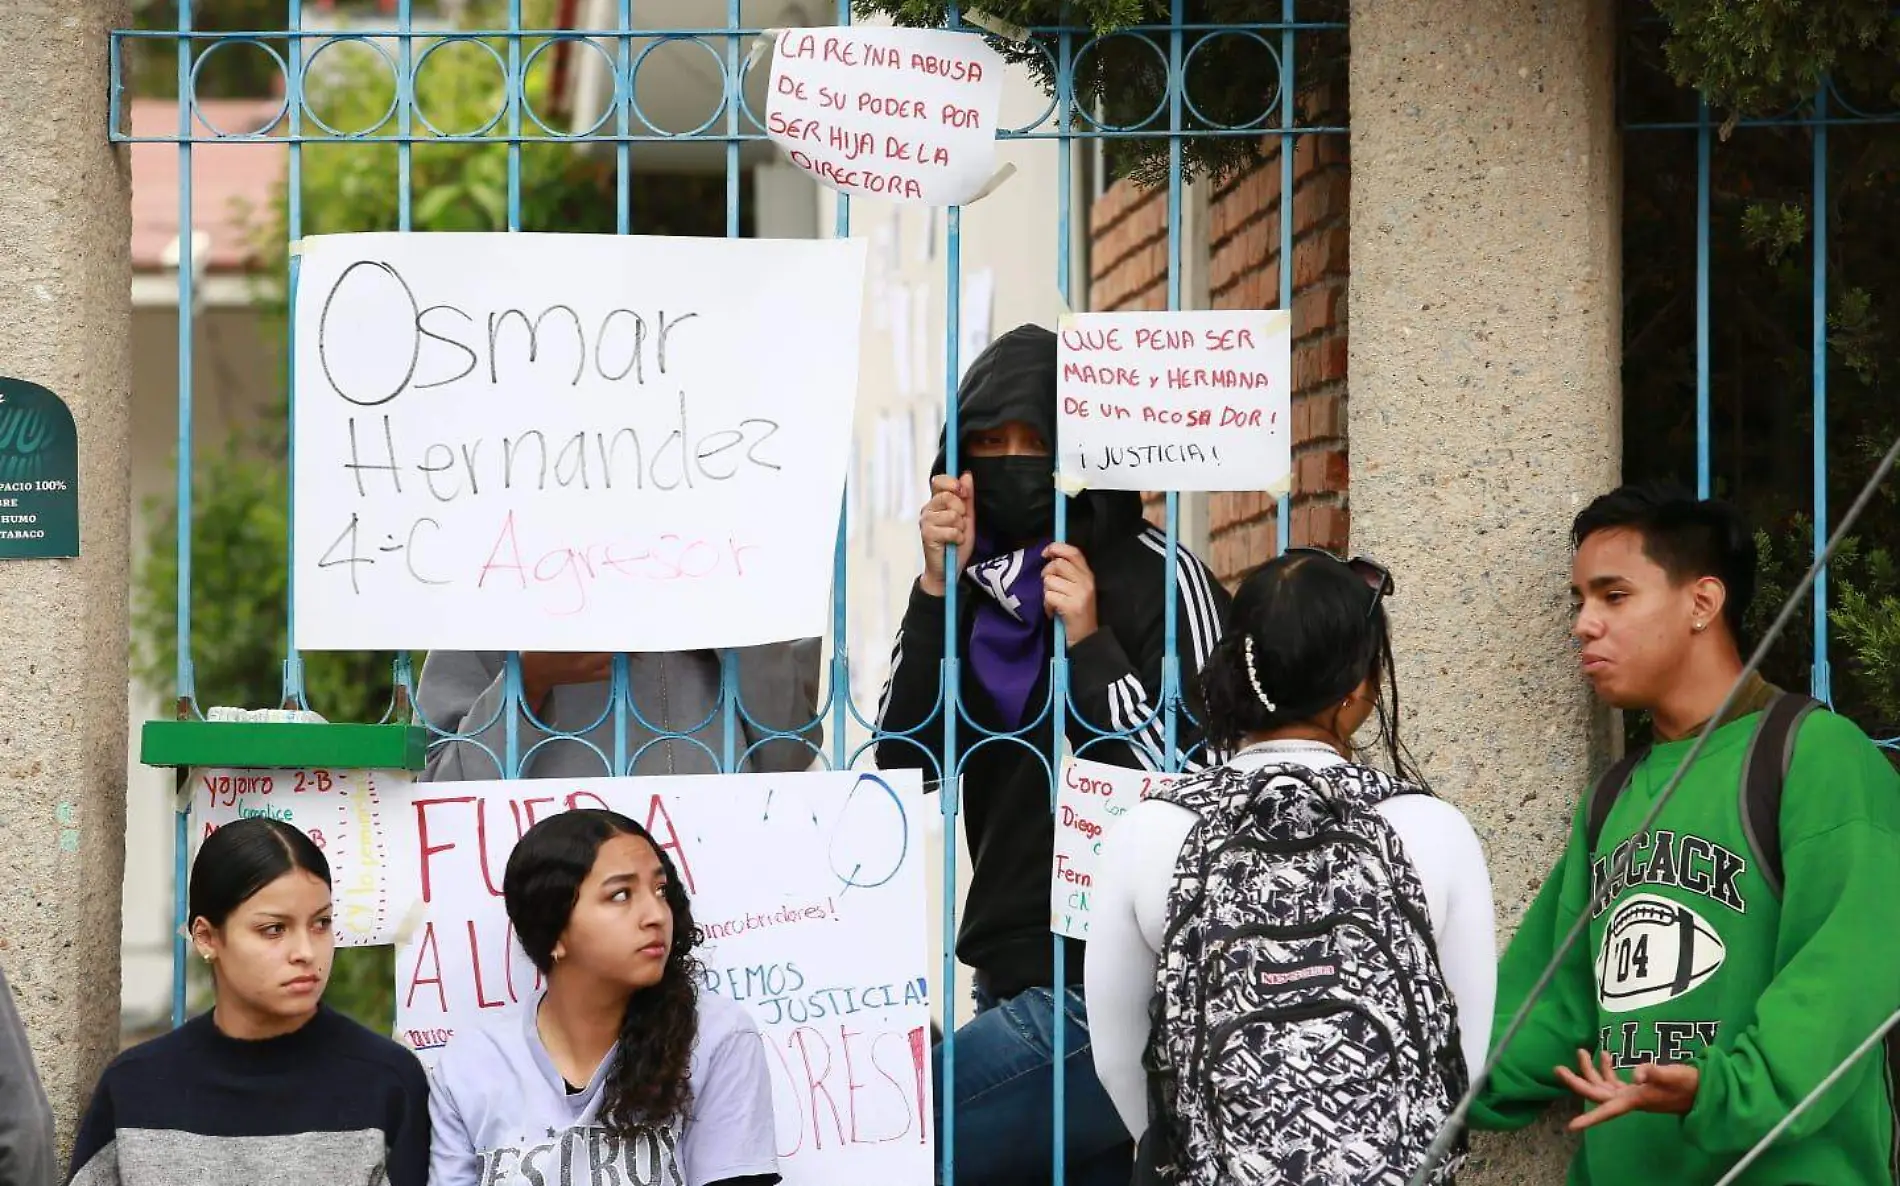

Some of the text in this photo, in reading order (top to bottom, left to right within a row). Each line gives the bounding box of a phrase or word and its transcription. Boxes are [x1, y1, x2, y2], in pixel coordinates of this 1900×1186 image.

[781, 30, 982, 82] LA REYNA ABUSA
[778, 75, 979, 128] DE SU PODER POR
[769, 112, 821, 142] SER
[830, 126, 874, 160] HIJA
[790, 150, 922, 198] DIRECTORA
[320, 260, 698, 406] Osmar
[1062, 329, 1255, 351] QUE PENA SER
[1064, 363, 1140, 386] MADRE
[1168, 368, 1269, 389] HERMANA
[1064, 397, 1089, 417] DE
[344, 390, 781, 502] Hernandez
[35, 481, 67, 491] 100%
[1, 515, 37, 523] HUMO
[479, 510, 761, 616] Agresor
[293, 770, 333, 793] 2-B
[1062, 805, 1102, 840] Diego
[411, 791, 697, 903] FUA
[1056, 854, 1092, 887] Fern
[704, 962, 804, 1001] REMOS
[758, 977, 930, 1025] JUSTICIA!
